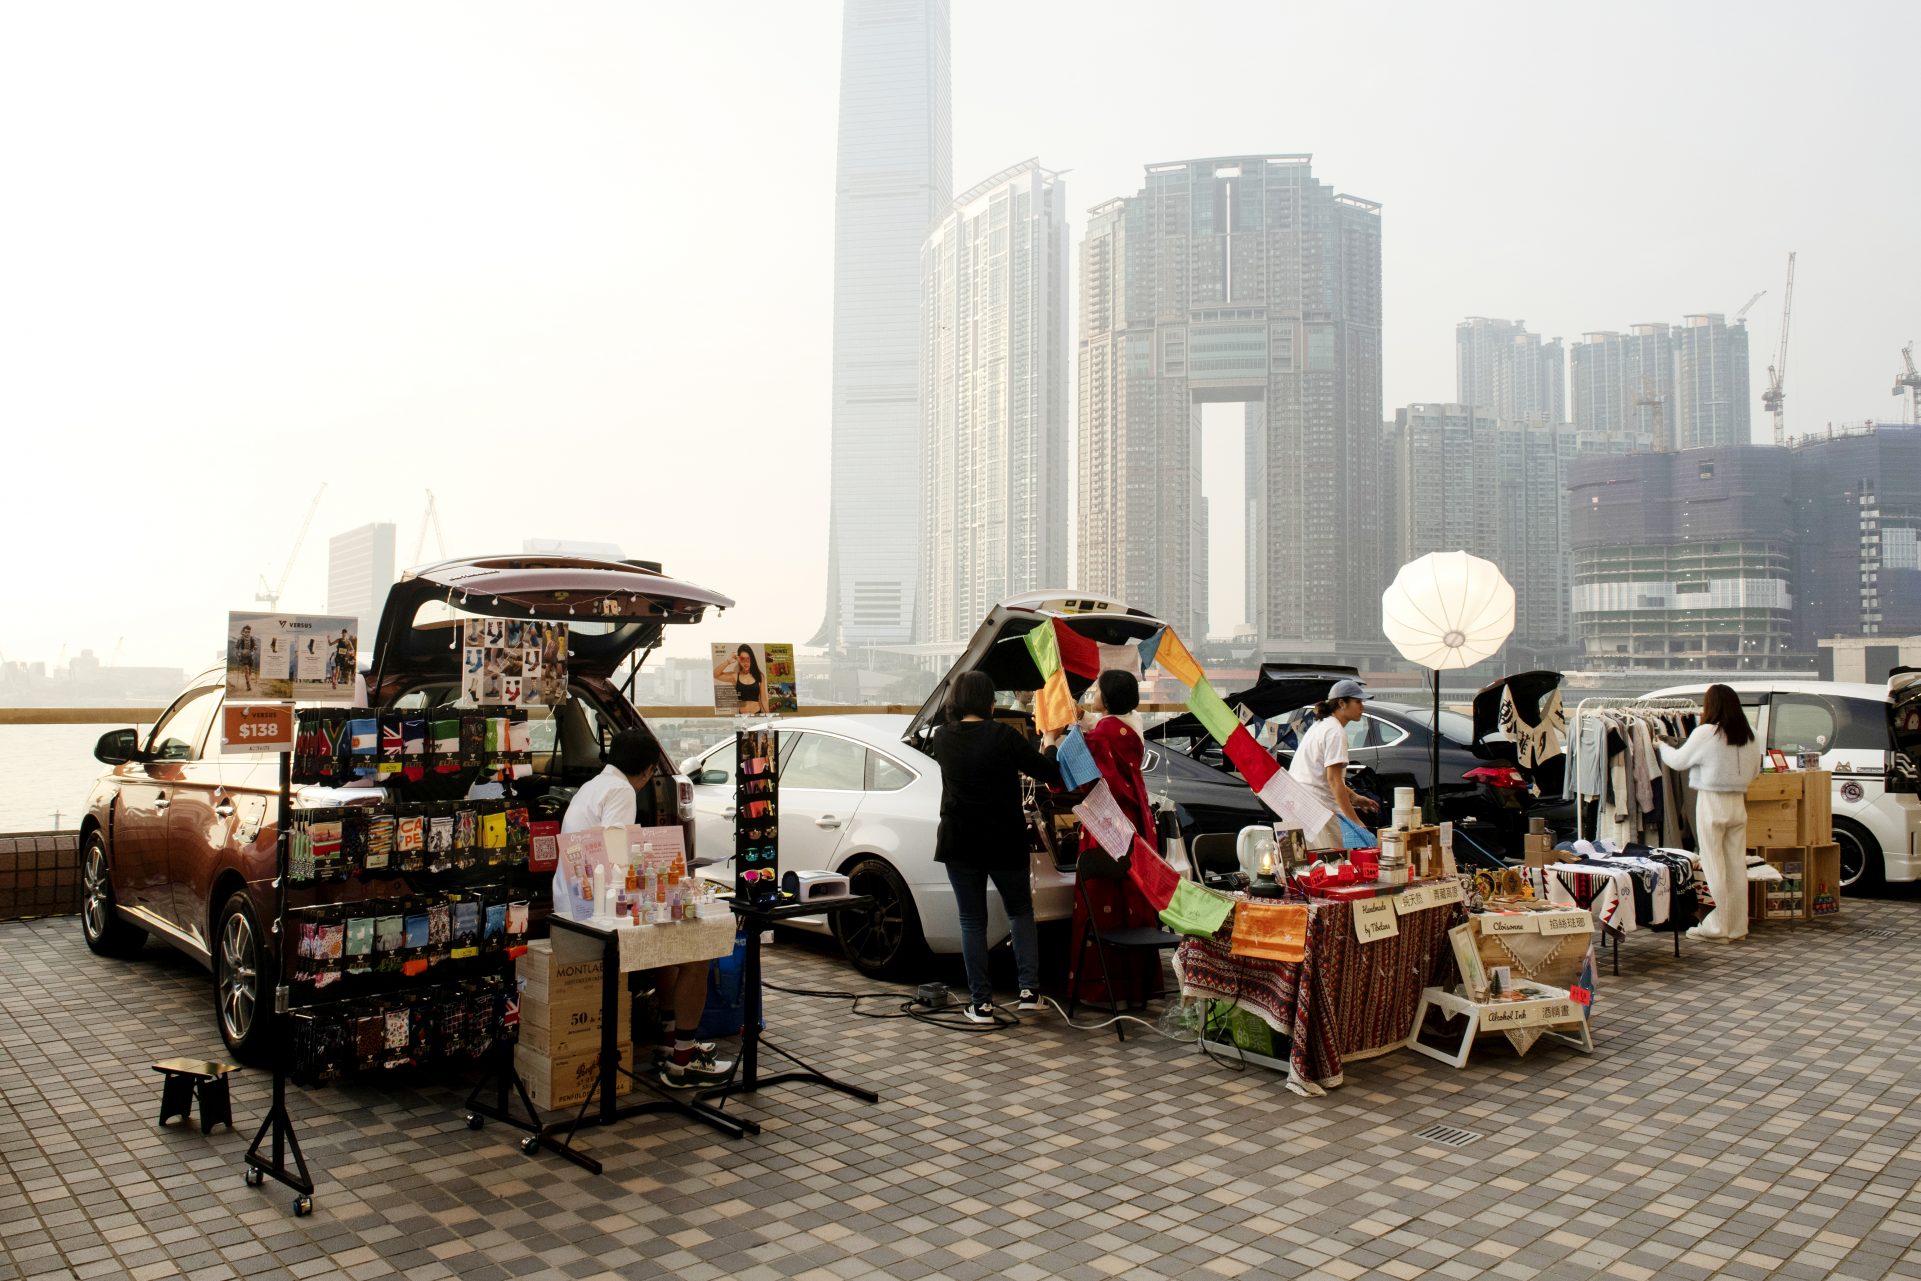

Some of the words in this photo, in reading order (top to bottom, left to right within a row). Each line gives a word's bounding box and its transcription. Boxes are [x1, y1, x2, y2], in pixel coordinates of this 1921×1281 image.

[239, 723, 279, 739] $138
[400, 818, 423, 833] CA
[404, 833, 422, 847] PE
[1402, 892, 1424, 907] 純天然
[1362, 901, 1387, 914] Handmade
[1364, 925, 1371, 937] by
[1371, 922, 1391, 932] Tibetans
[1493, 921, 1524, 931] Cloisonne
[571, 1012, 588, 1025] 50
[1488, 1010, 1514, 1022] Alcohol
[1515, 1010, 1527, 1020] Ink
[1542, 1005, 1570, 1019] 酒精畫
